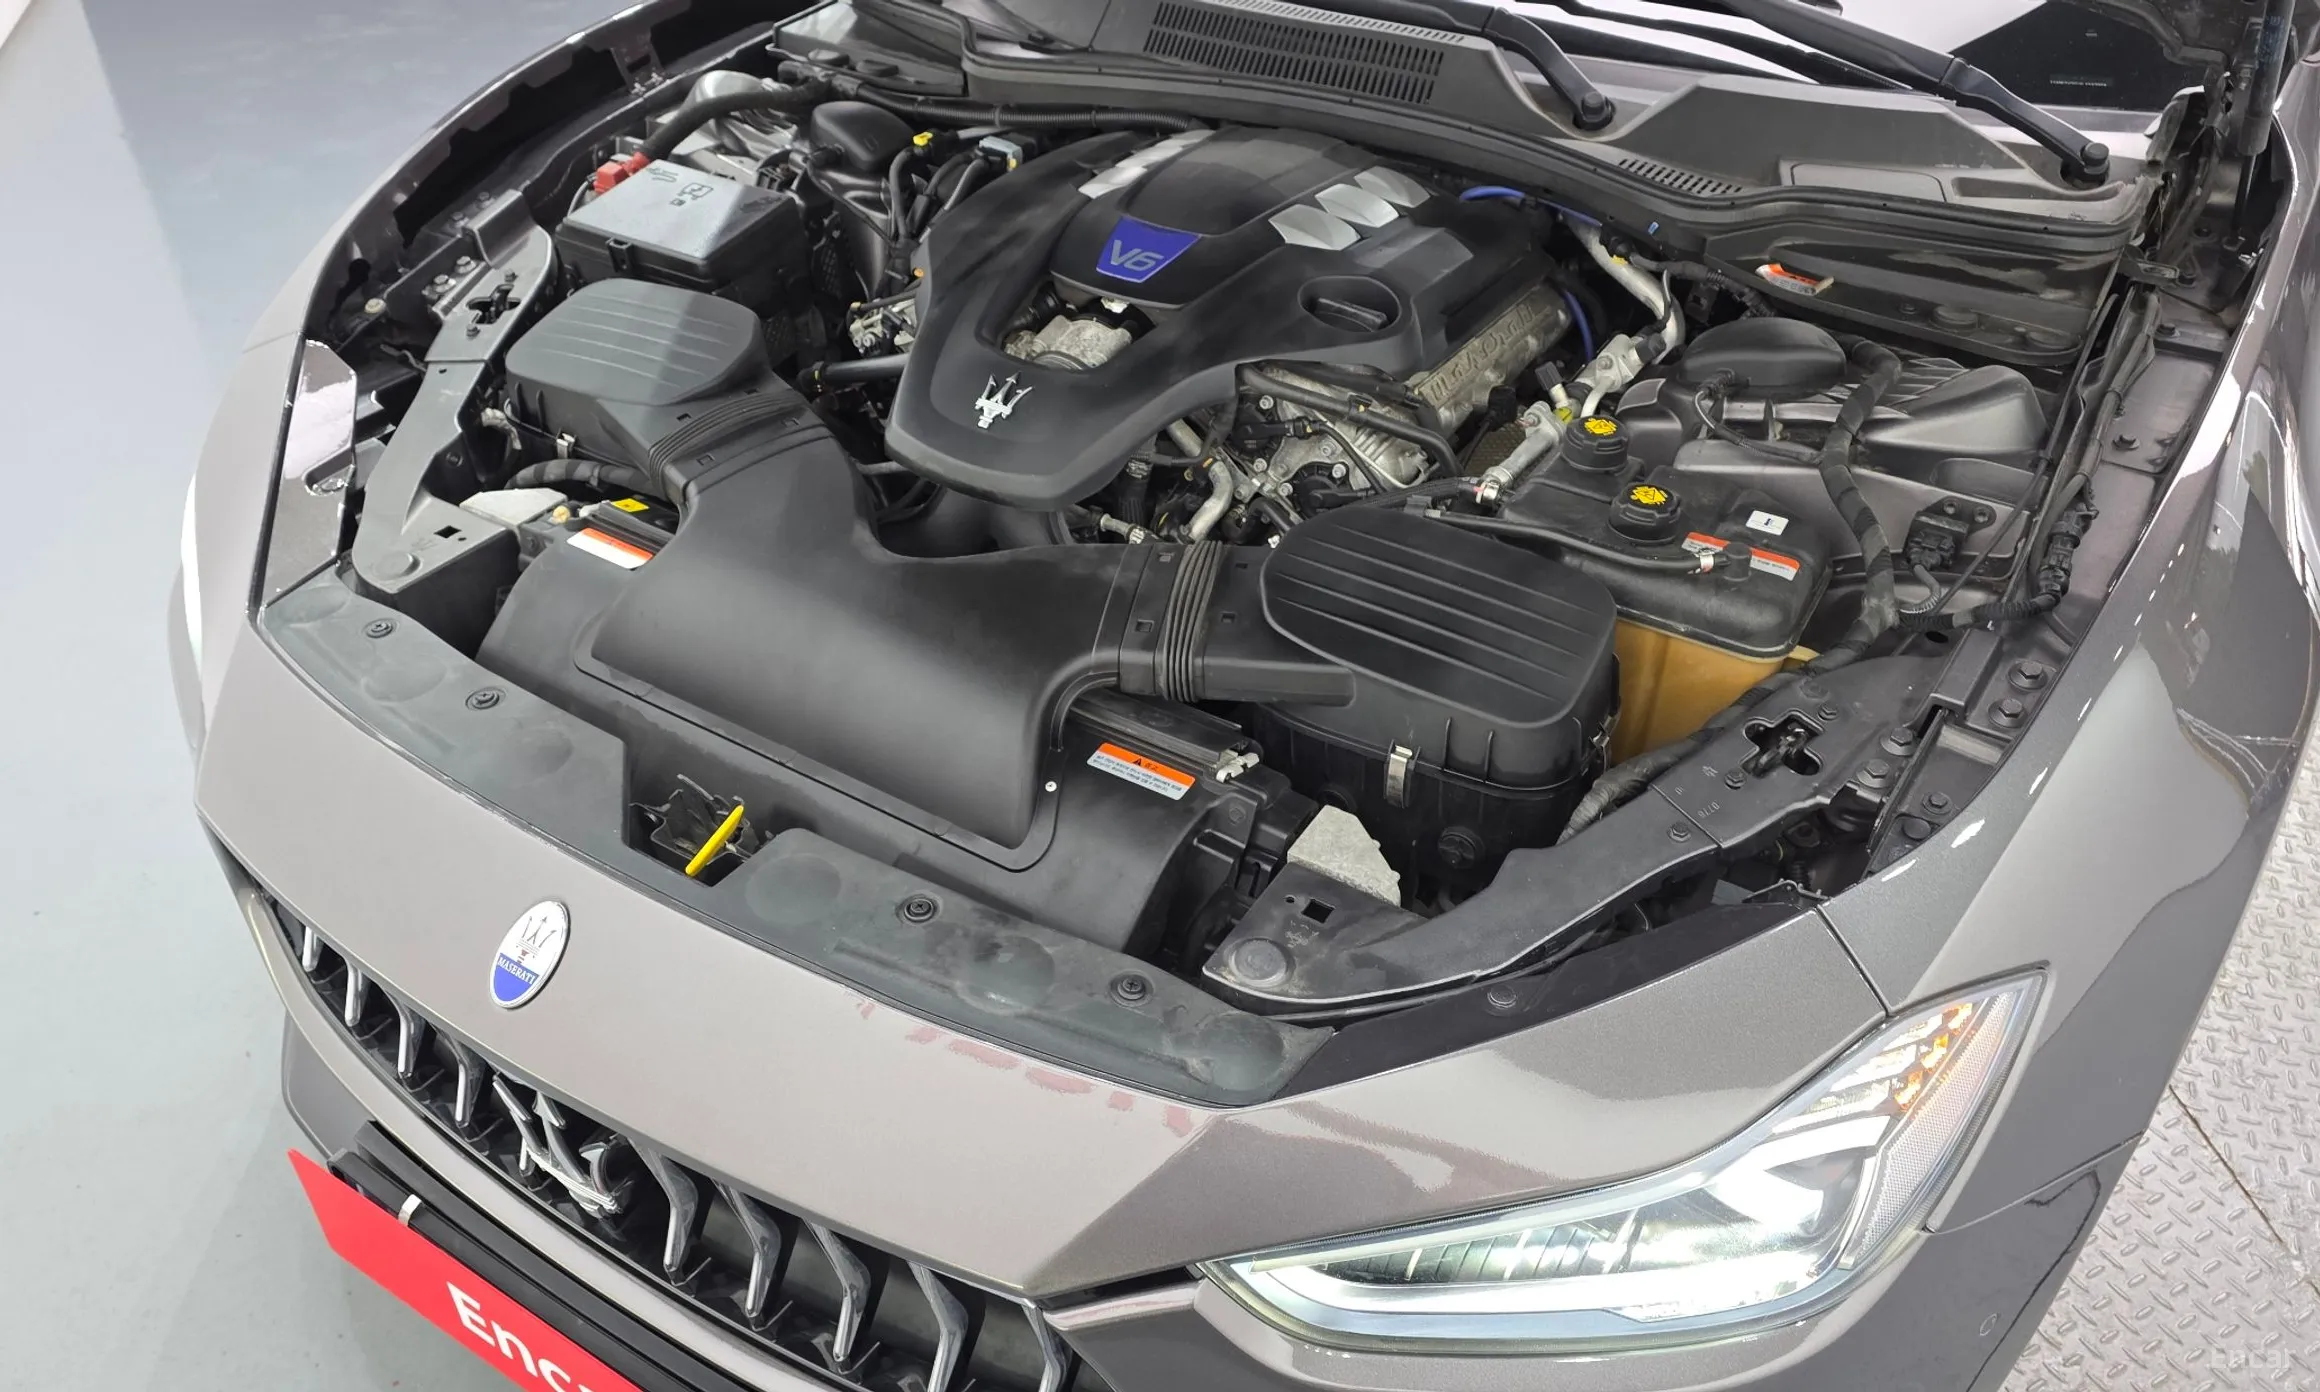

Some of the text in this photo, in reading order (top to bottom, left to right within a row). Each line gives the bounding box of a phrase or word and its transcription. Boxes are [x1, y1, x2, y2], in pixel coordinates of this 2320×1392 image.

[1110, 239, 1165, 272] V6
[497, 956, 536, 985] MASERATI
[446, 1280, 594, 1392] Enc
